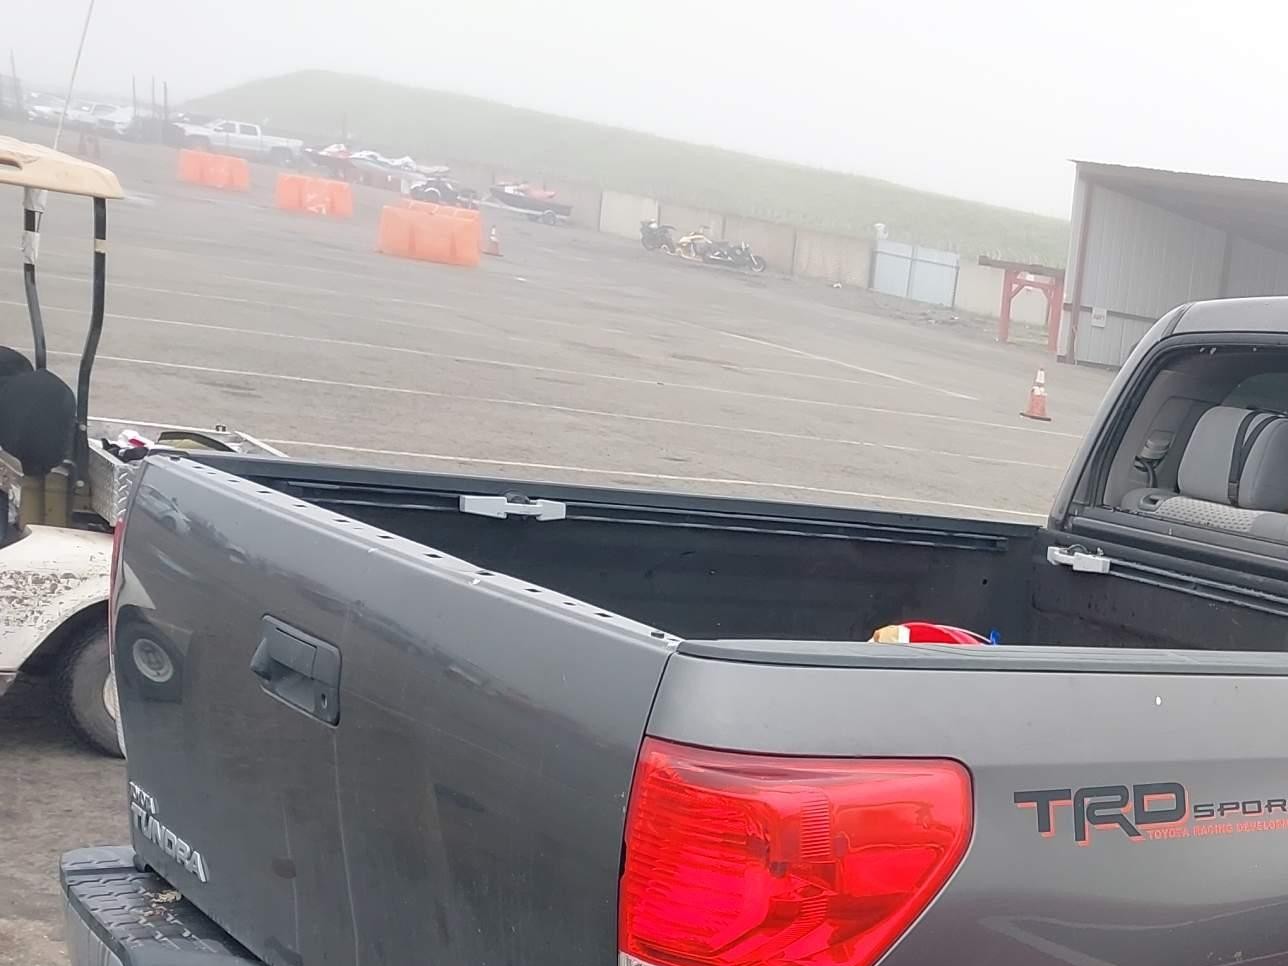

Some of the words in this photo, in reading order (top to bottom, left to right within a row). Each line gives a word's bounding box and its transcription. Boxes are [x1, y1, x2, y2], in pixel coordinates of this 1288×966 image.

[131, 801, 209, 882] TUNDRA
[1014, 783, 1190, 845] TRD
[1147, 826, 1190, 840] TOYOTA
[1193, 823, 1233, 838] RACING
